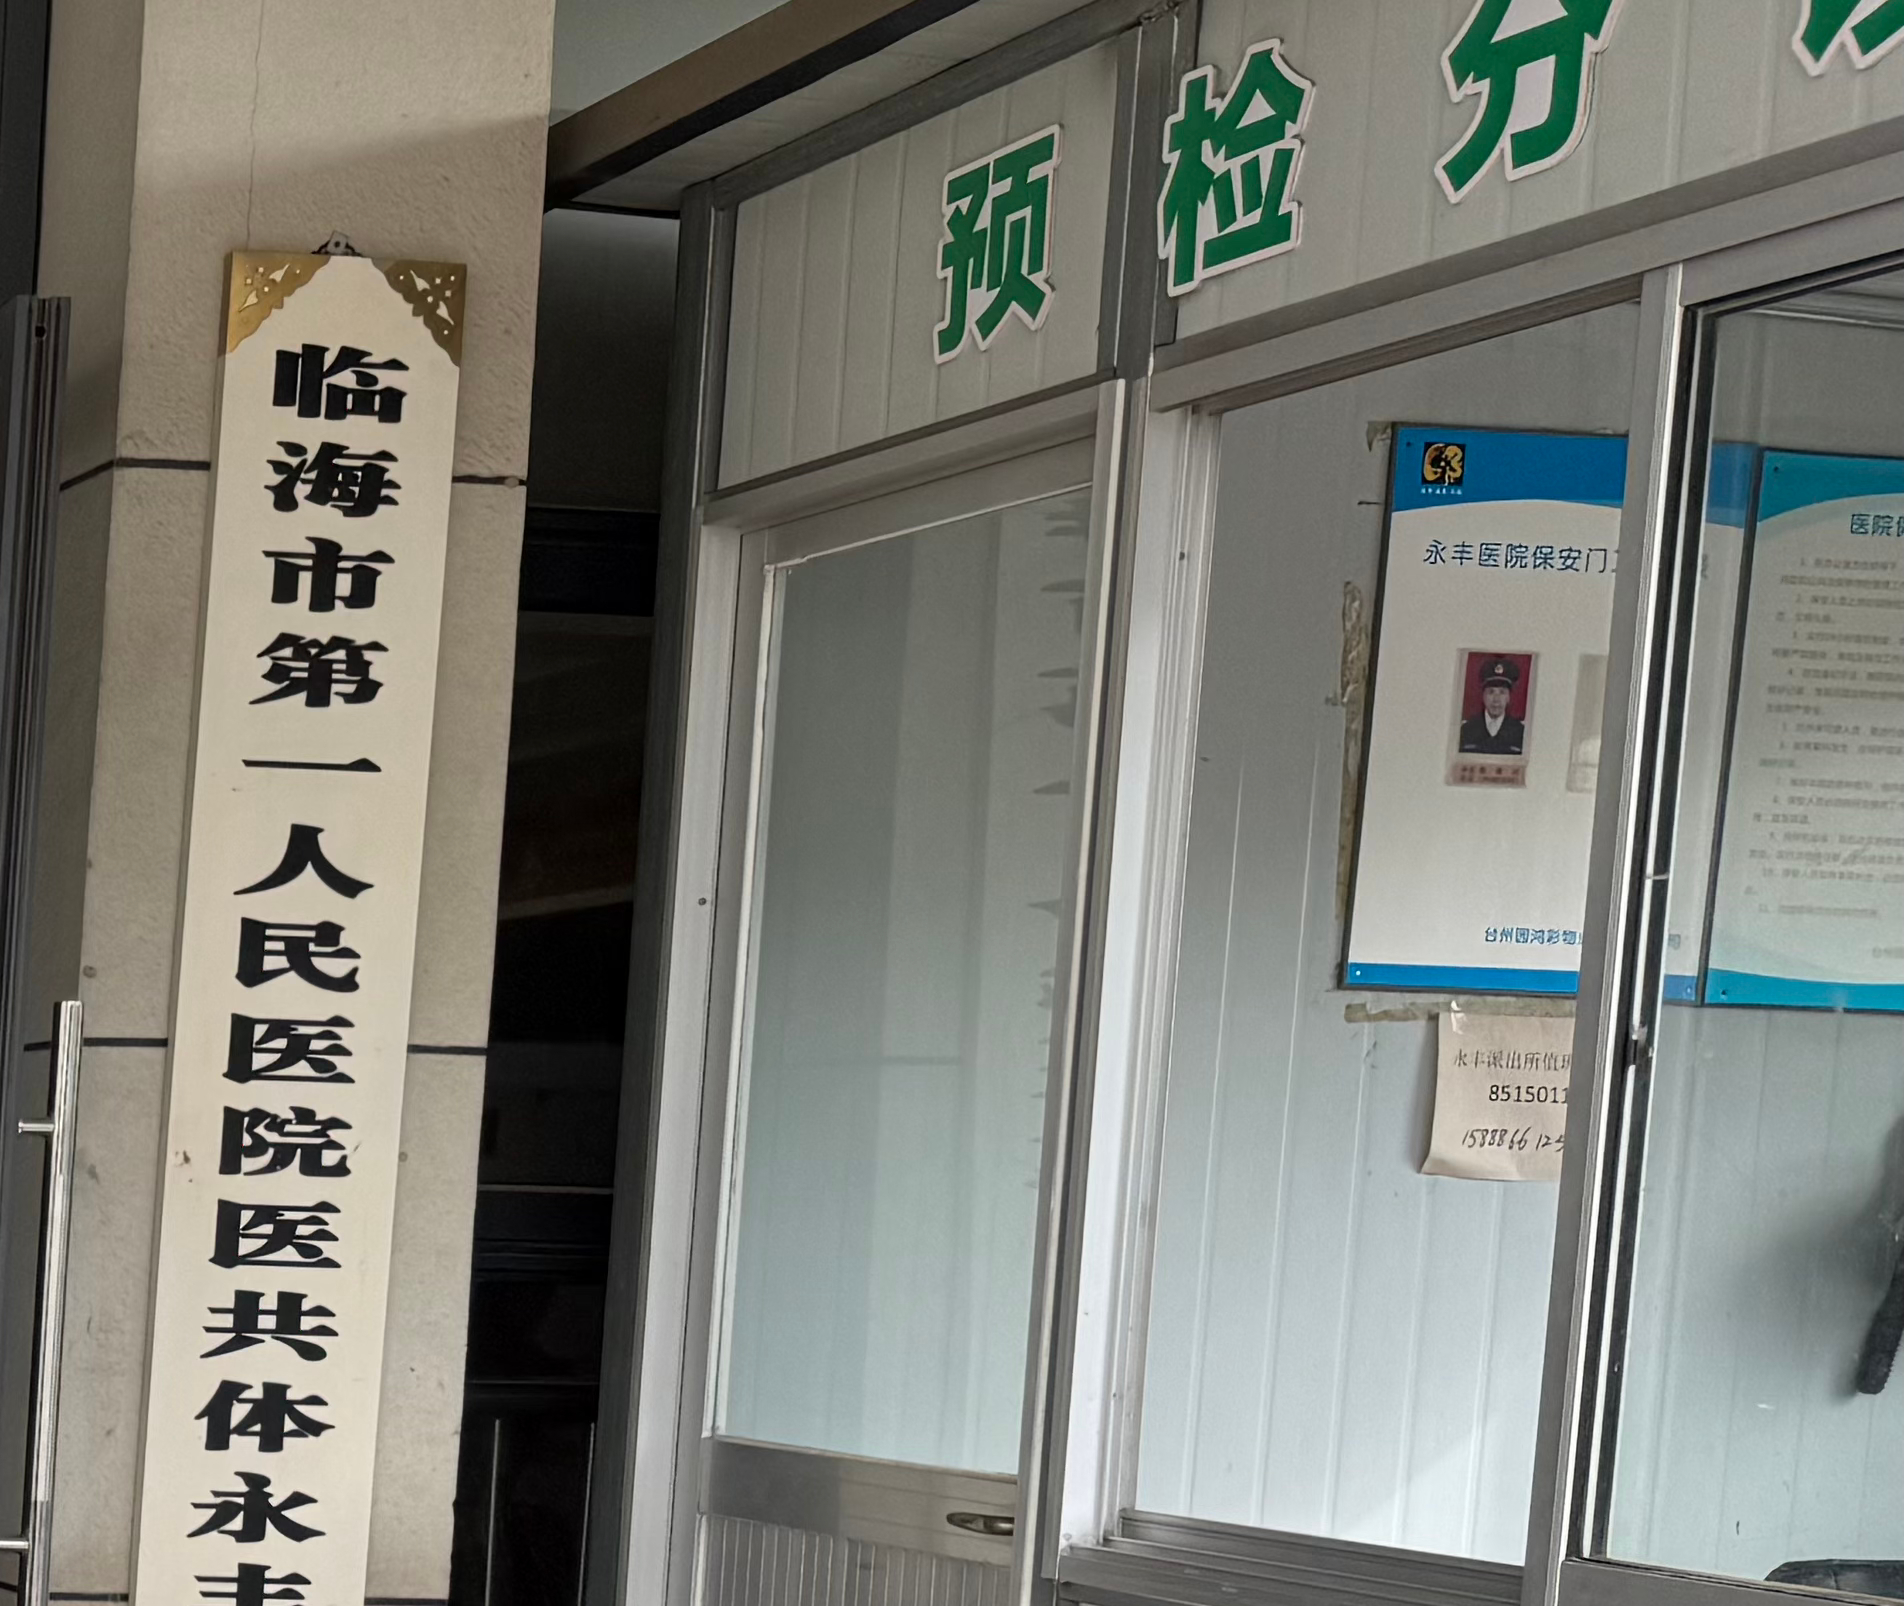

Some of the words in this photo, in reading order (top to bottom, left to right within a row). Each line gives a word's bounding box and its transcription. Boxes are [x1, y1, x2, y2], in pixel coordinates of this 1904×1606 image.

[934, 0, 1904, 362] 预检分
[1423, 539, 1617, 573] 永丰医院保安门
